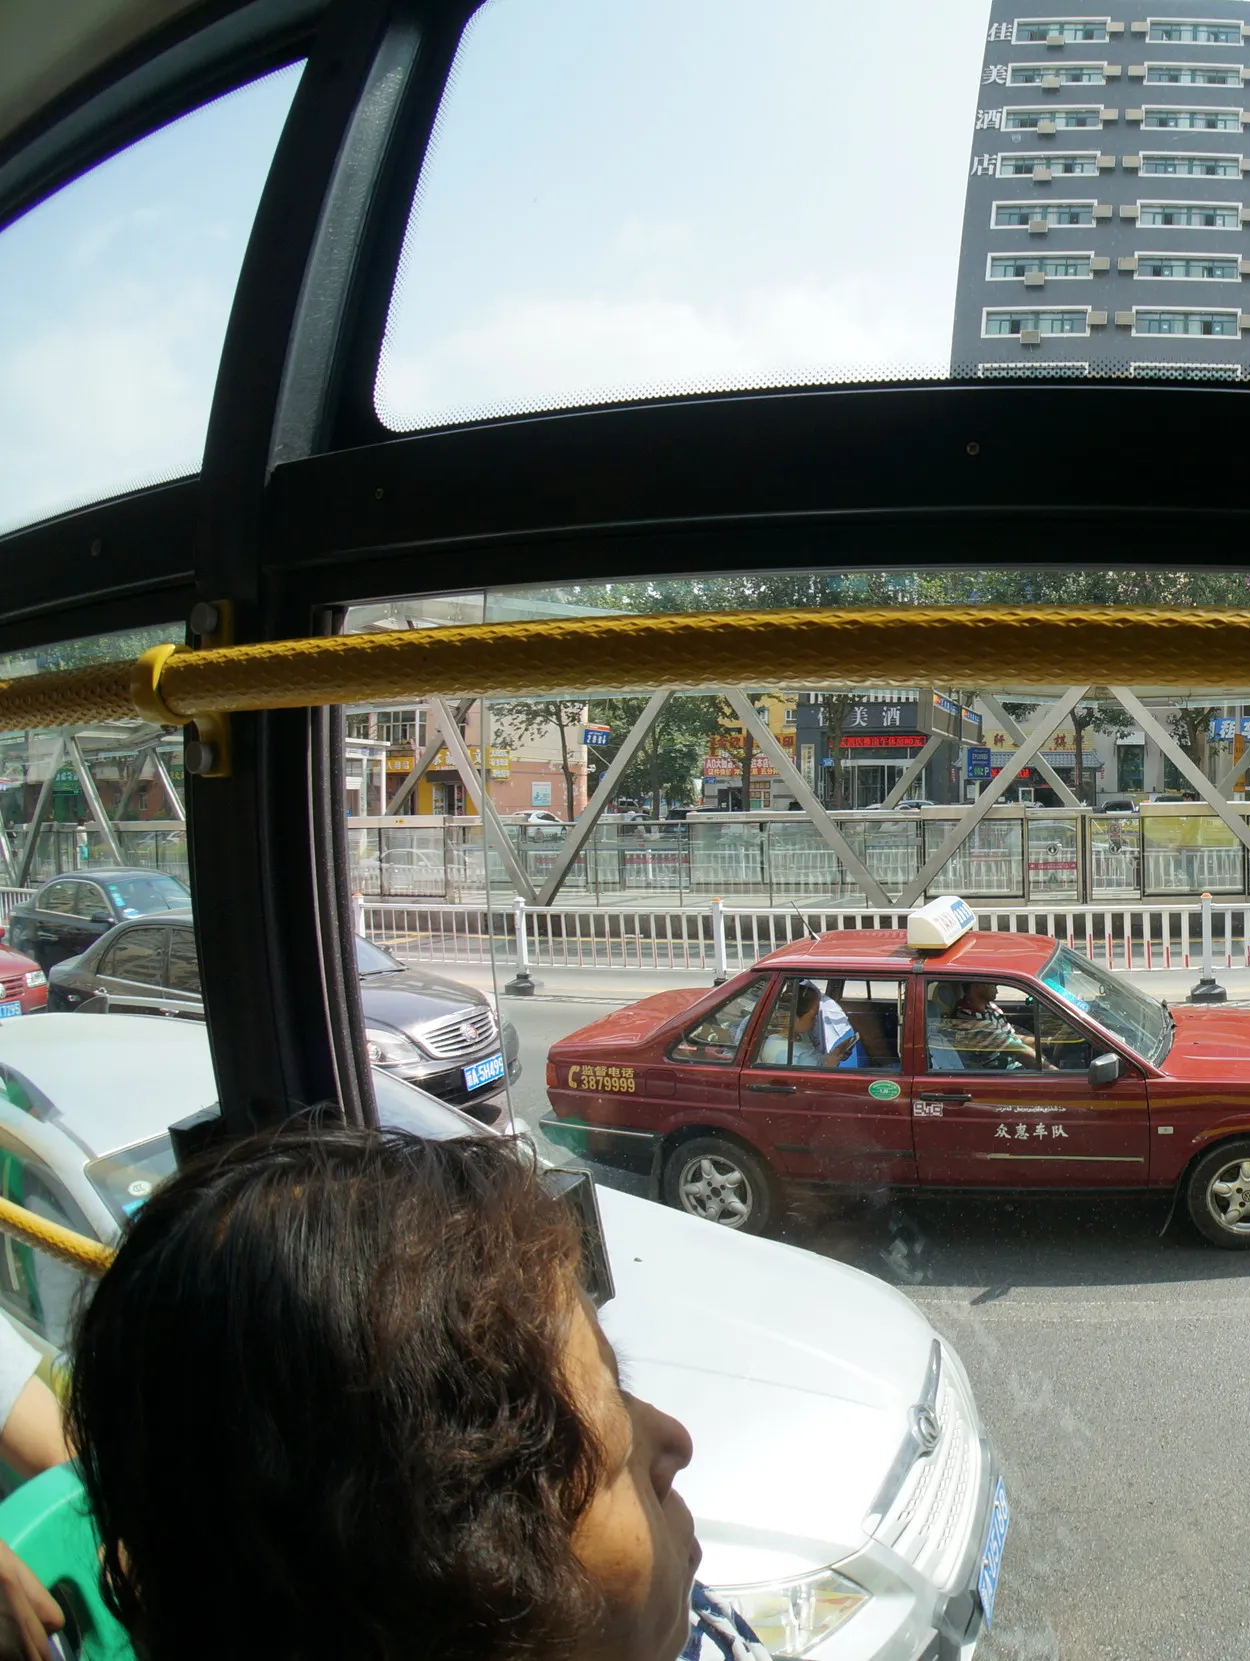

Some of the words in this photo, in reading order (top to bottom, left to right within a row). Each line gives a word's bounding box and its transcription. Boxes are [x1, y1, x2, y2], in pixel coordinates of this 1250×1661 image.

[970, 22, 1013, 176] 佳美酒店
[581, 1065, 634, 1078] 监督电话
[581, 1075, 635, 1092] 3879999
[994, 1122, 1069, 1140] 众惠车队
